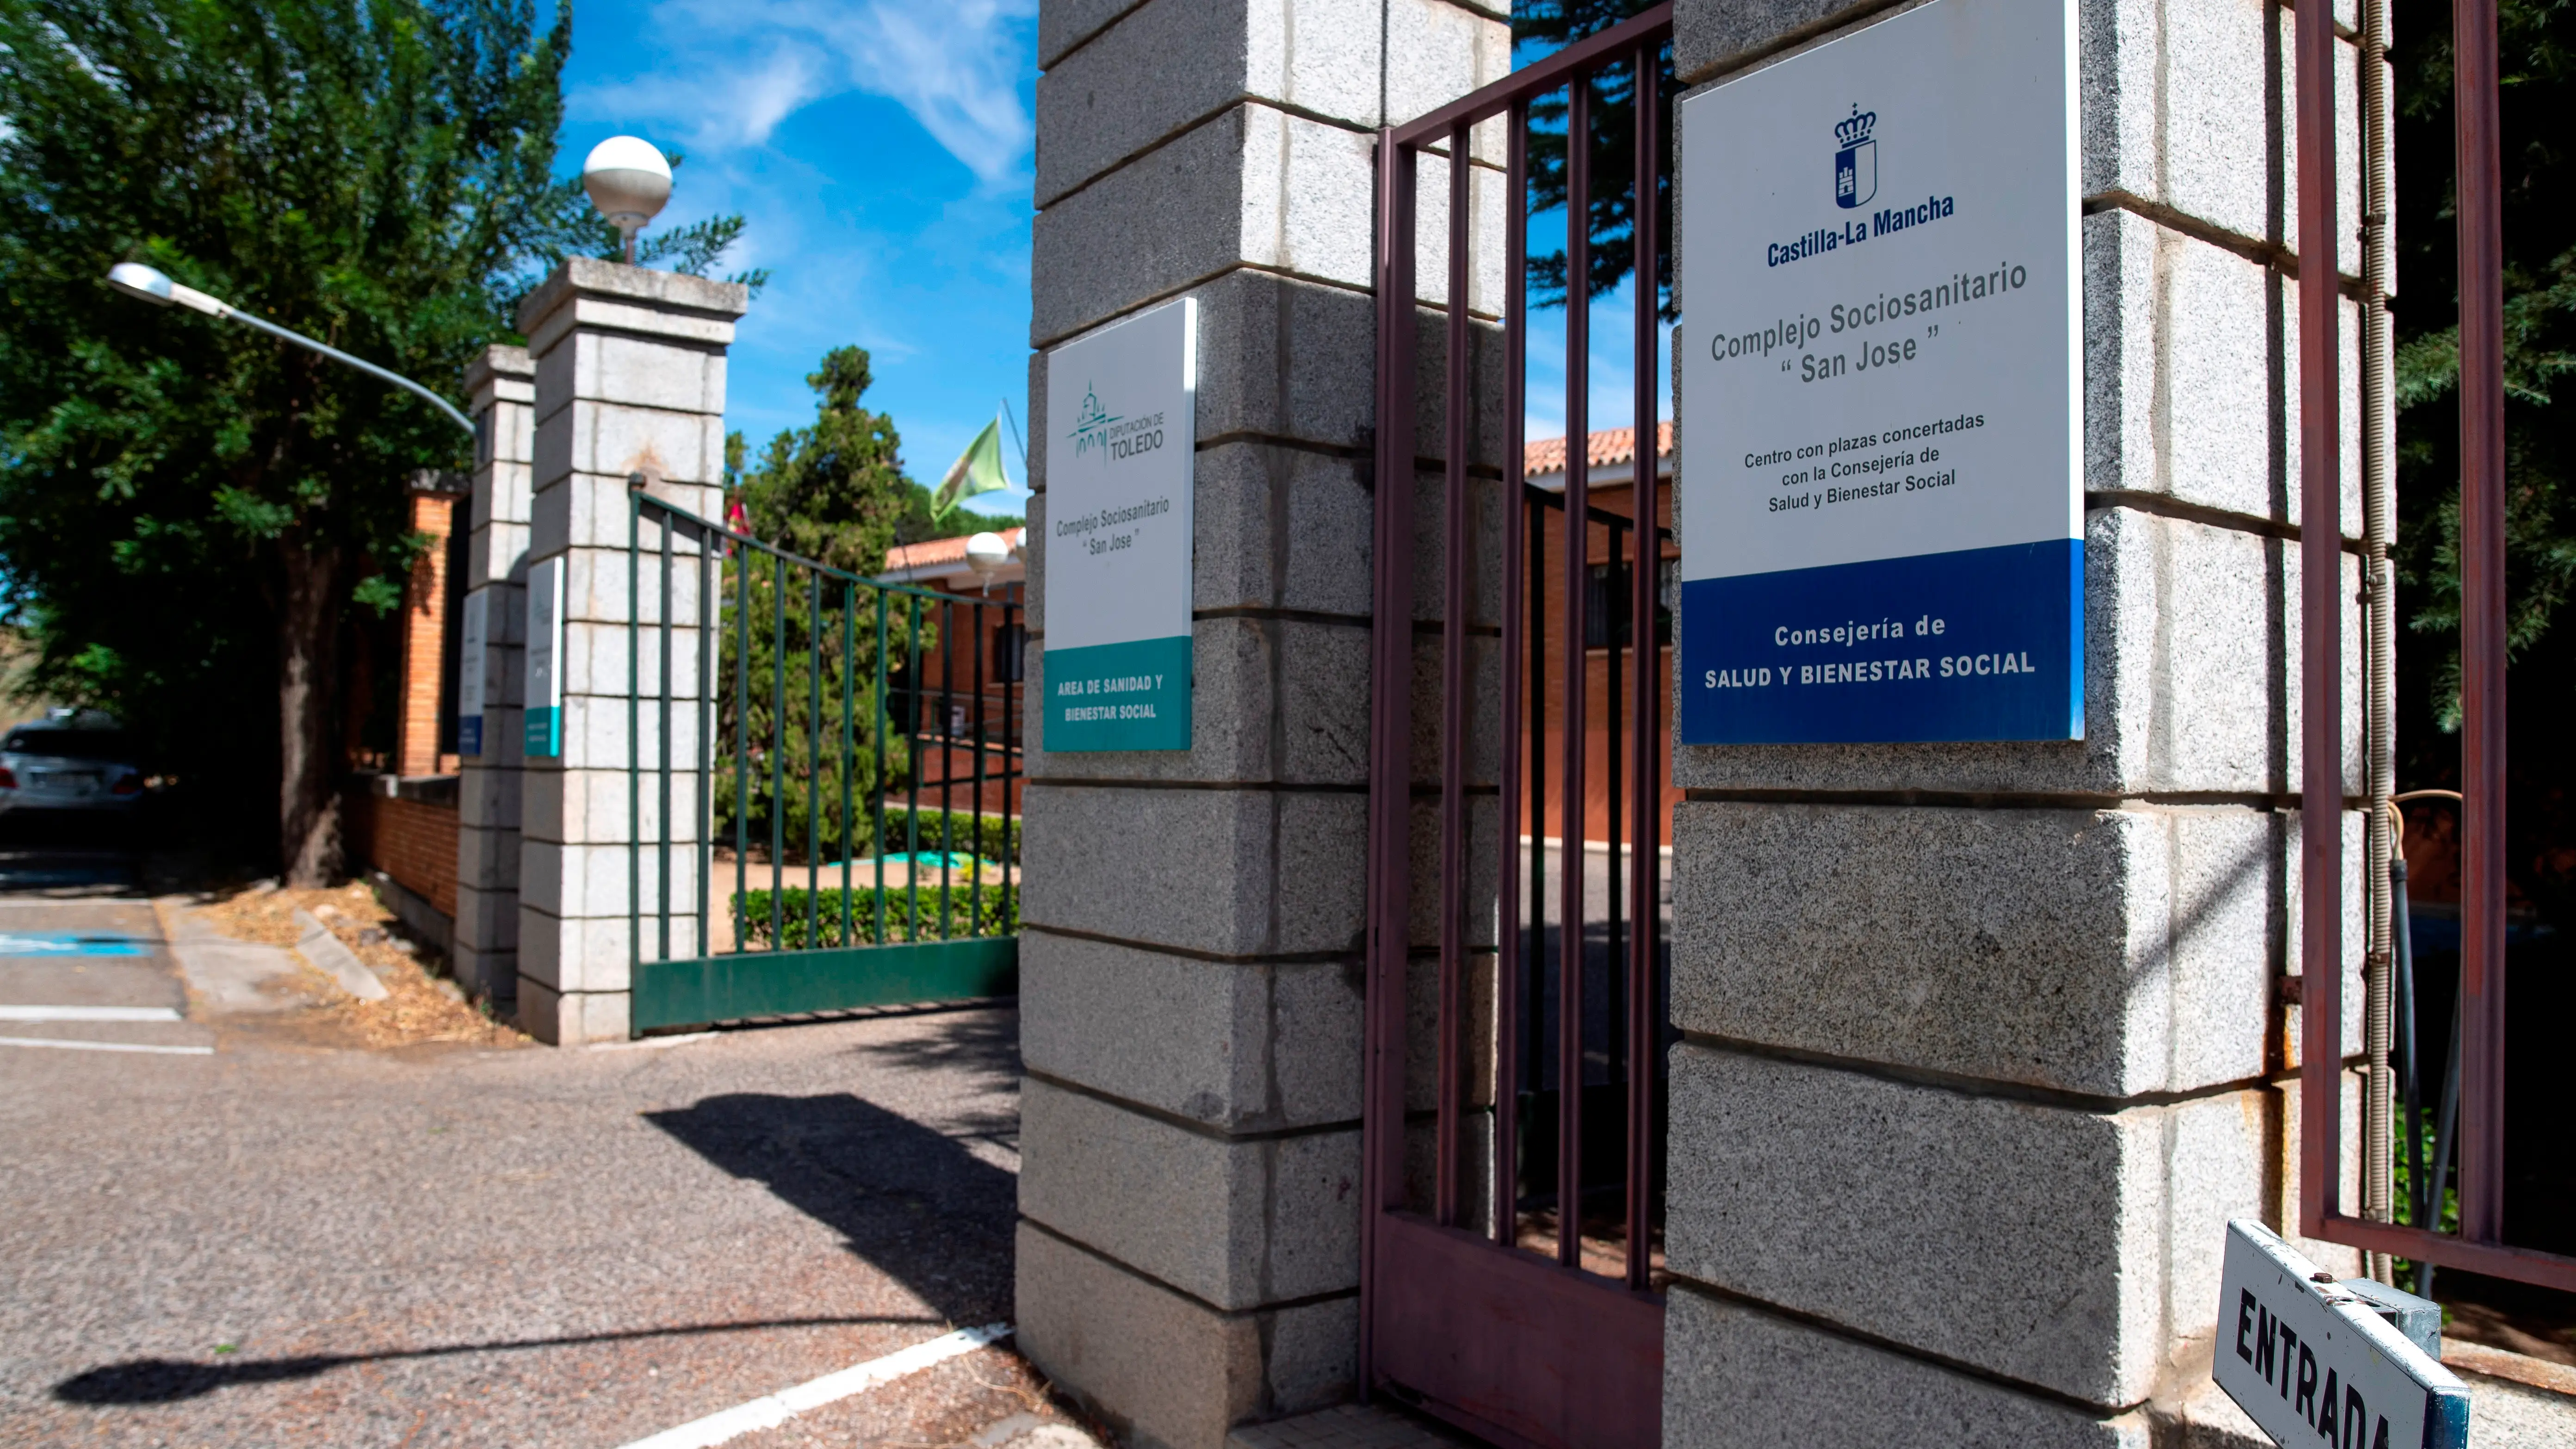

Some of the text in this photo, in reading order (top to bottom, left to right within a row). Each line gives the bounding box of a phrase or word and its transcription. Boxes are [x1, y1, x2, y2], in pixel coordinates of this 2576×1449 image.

[1767, 195, 1954, 268] Castilla-La Mancha
[1711, 261, 2027, 361] Complejo Sociosanitario
[1801, 354, 1845, 383] San
[1856, 338, 1916, 372] Jose
[1109, 412, 1164, 440] DIPUTACIÓN DE
[1110, 429, 1164, 461] TOLEDO
[1745, 414, 1985, 468] Centro con plazas concertadas
[1782, 446, 1939, 486] con la Consejería de
[1769, 469, 1955, 512] Salud y Bienestar Social
[1056, 495, 1170, 537] Complejo Sociosanitario
[1090, 538, 1107, 556] San
[1109, 533, 1132, 552] Jose
[1775, 614, 1945, 647] Consejería de
[1057, 674, 1163, 696] AREA DE SANIDAD Y
[1705, 651, 2035, 688] SALUD Y BIENESTAR SOCIAL
[1065, 703, 1157, 722] BIENESTAR SOCIAL
